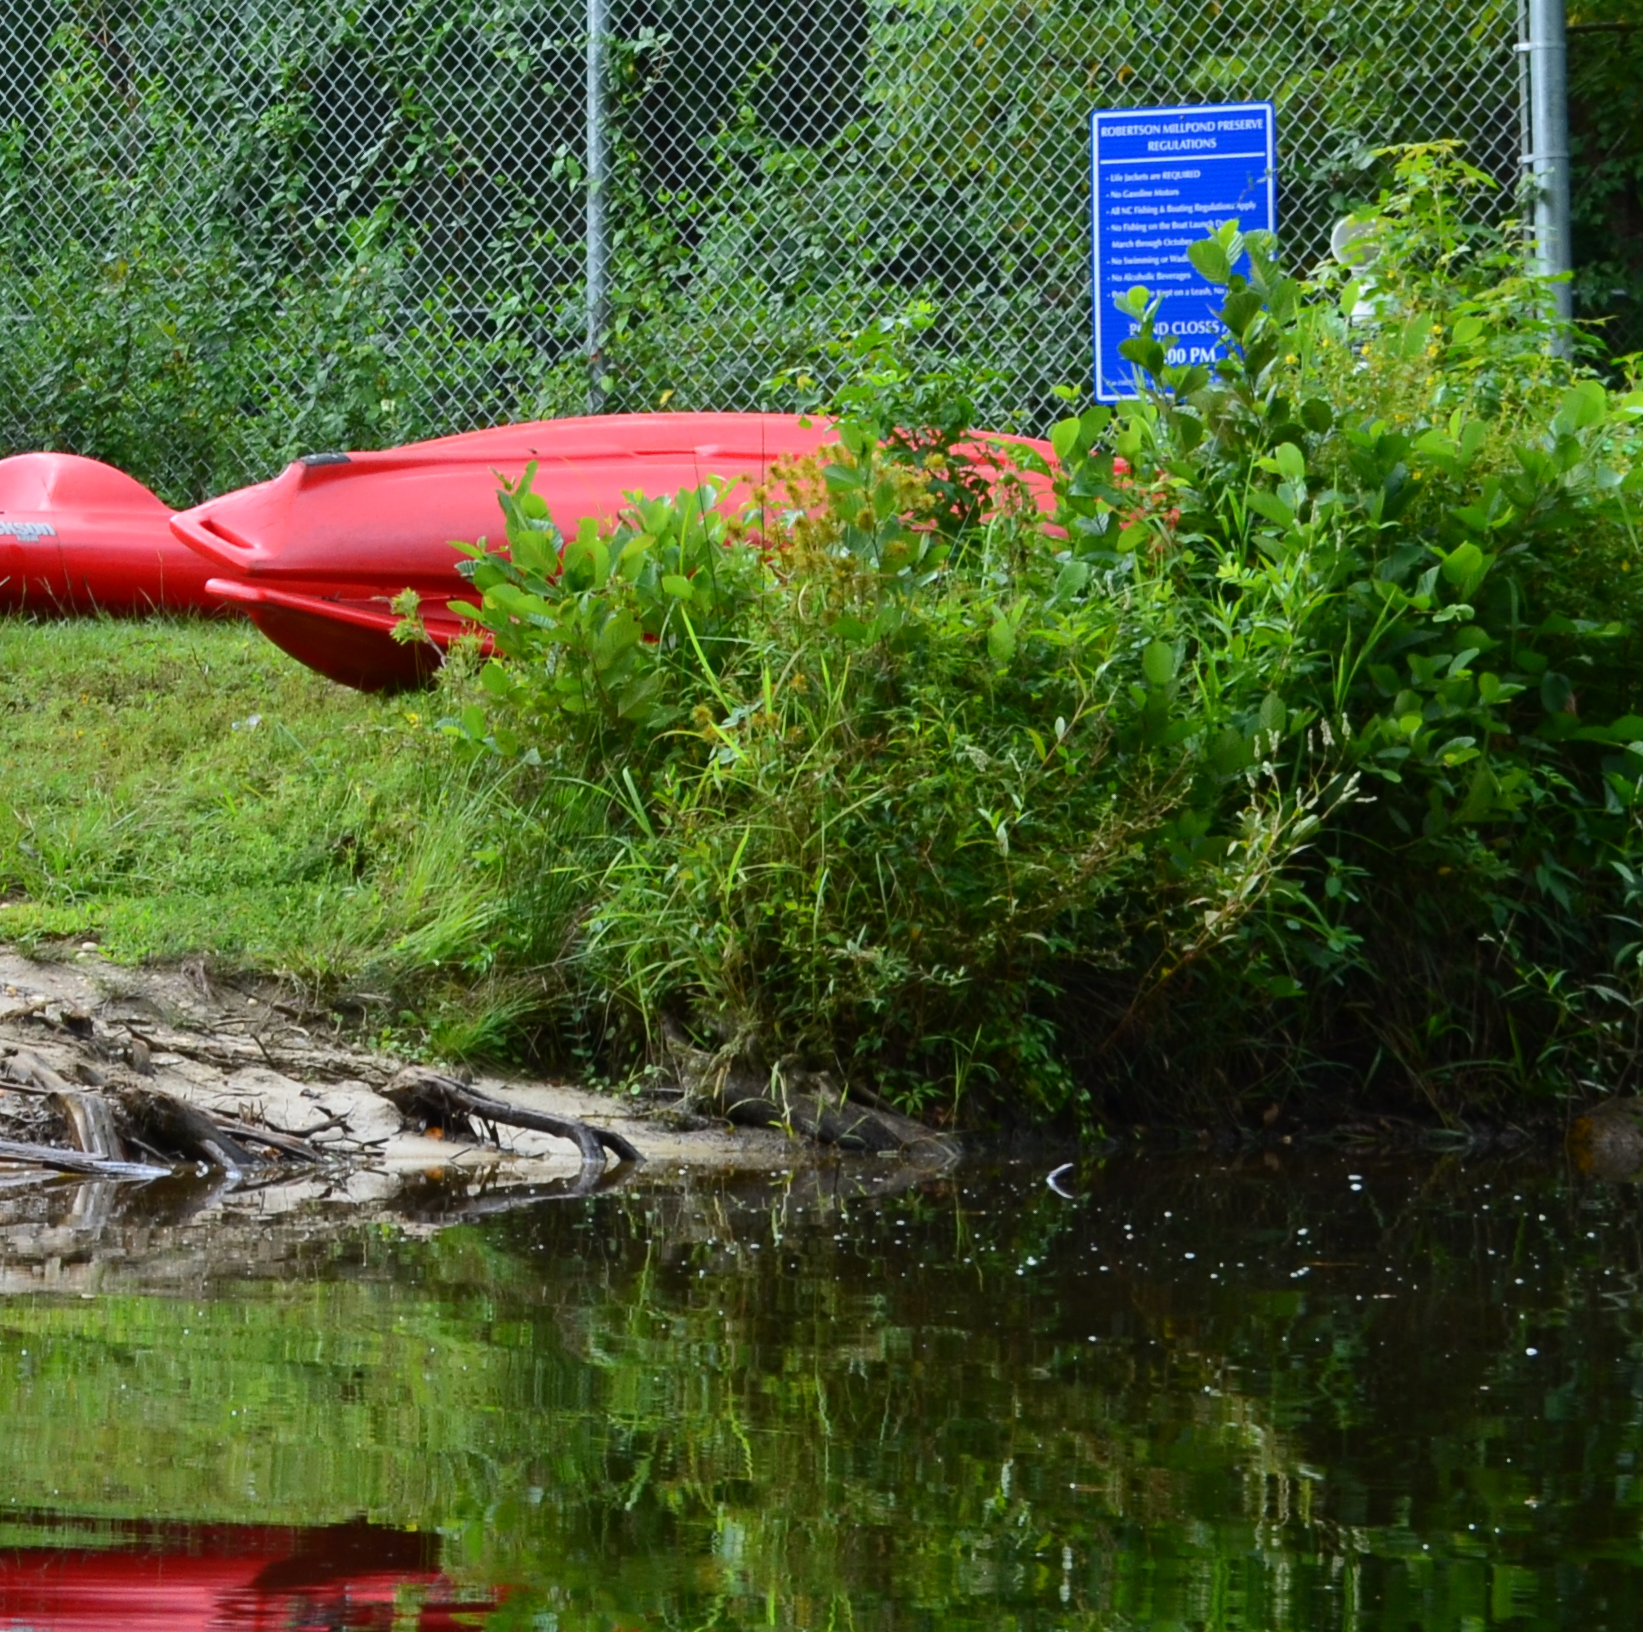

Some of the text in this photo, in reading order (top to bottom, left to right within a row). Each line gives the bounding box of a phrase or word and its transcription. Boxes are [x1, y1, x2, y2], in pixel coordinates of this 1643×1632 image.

[1101, 119, 1264, 137] ROBERTSON MILLPOND PRESERVE
[1147, 138, 1217, 151] REGULATIONS
[1162, 170, 1201, 179] REQUIRED
[1111, 224, 1122, 232] No
[1111, 257, 1123, 265] No
[1171, 320, 1220, 335] CLOSES
[1190, 347, 1216, 364] PM
